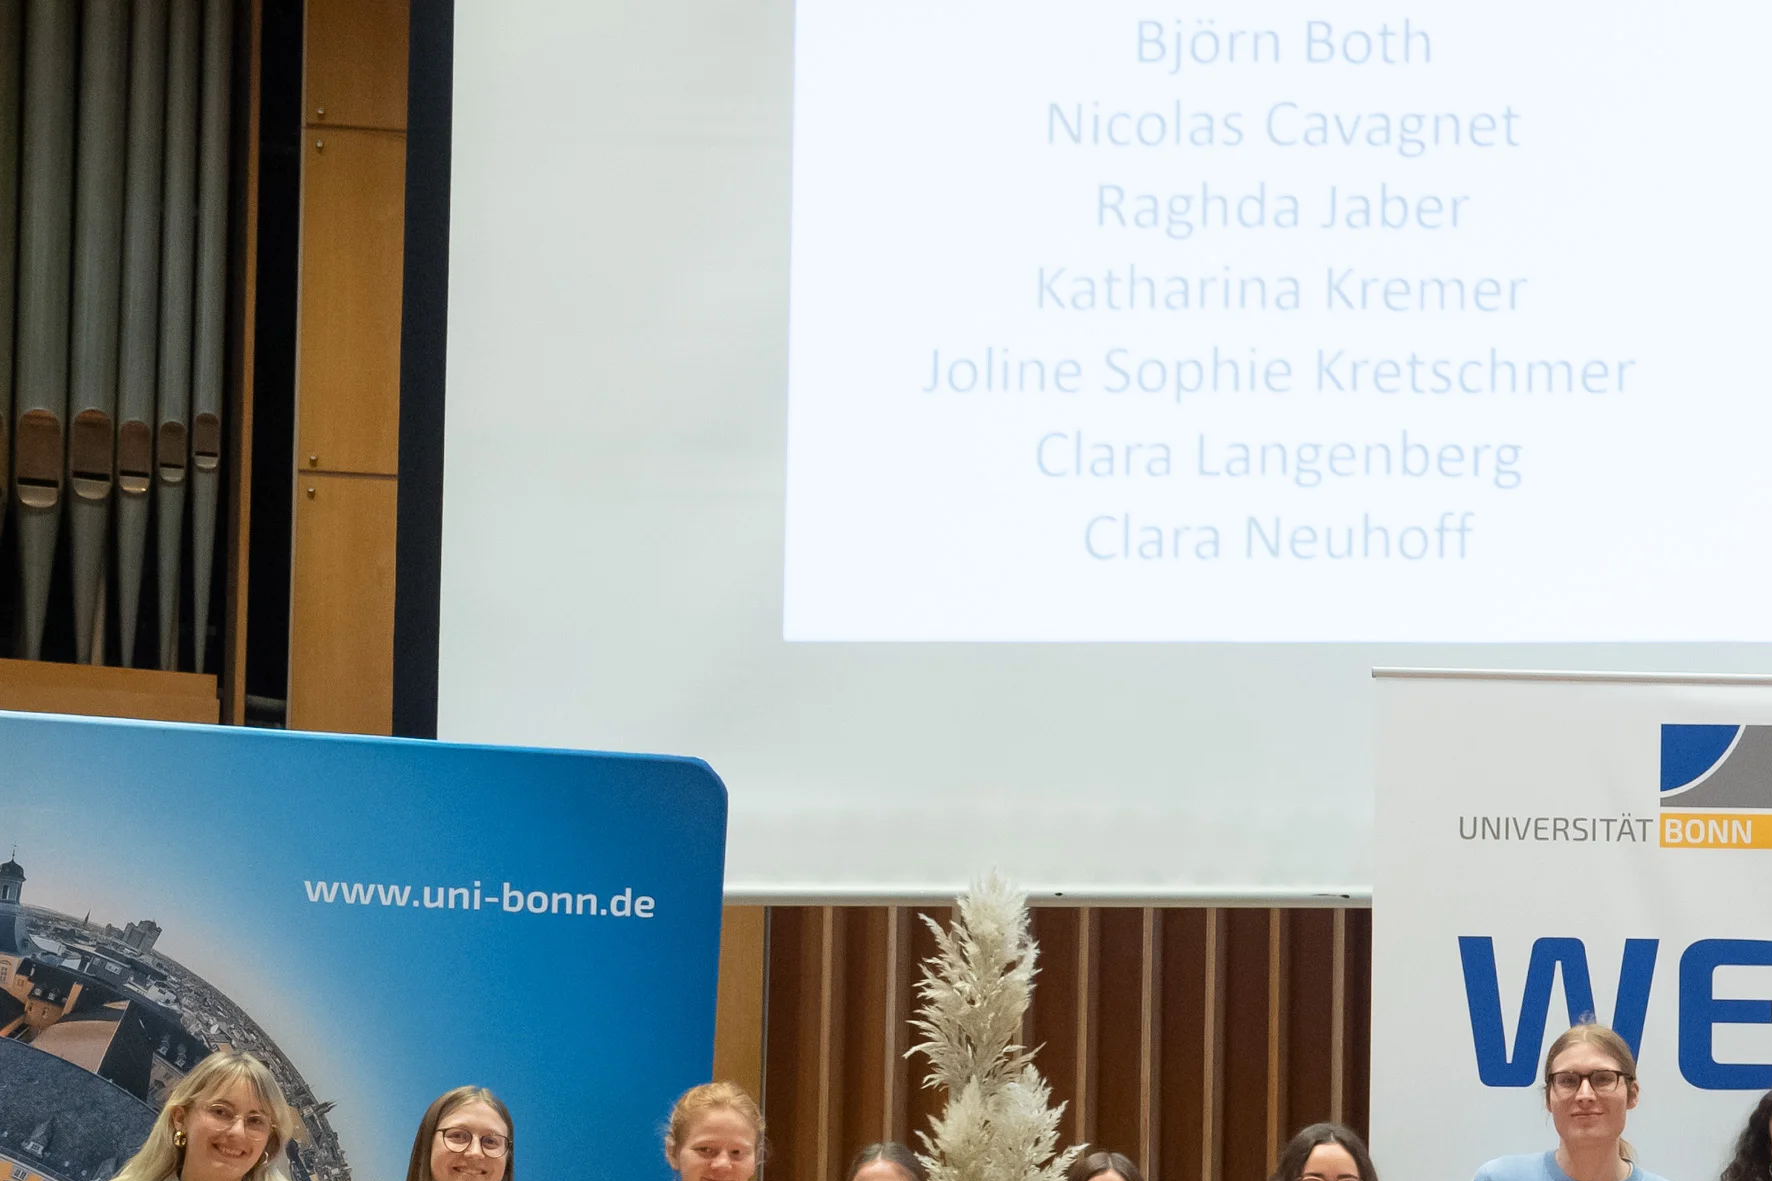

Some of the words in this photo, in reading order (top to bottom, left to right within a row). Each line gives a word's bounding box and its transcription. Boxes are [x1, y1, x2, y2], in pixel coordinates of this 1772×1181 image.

[1136, 18, 1280, 76] Björn
[1305, 17, 1432, 66] Both
[1047, 98, 1244, 148] Nicolas
[1265, 100, 1522, 159] Cavagnet
[1097, 181, 1300, 240] Raghda
[1320, 181, 1471, 230] Jaber
[1037, 263, 1300, 312] Katharina
[1326, 266, 1529, 313] Kremer
[922, 345, 1082, 394] Joline
[1103, 345, 1292, 405] Sophie
[1316, 347, 1637, 395] Kretschmer
[1035, 429, 1173, 478] Clara
[1197, 429, 1524, 490] Langenberg
[1083, 512, 1222, 561] Clara
[1245, 511, 1476, 561] Neuhoff
[1459, 813, 1653, 842] UNIVERSITÄT
[1664, 818, 1752, 844] BONN
[304, 880, 656, 919] www.uni-bonn.de
